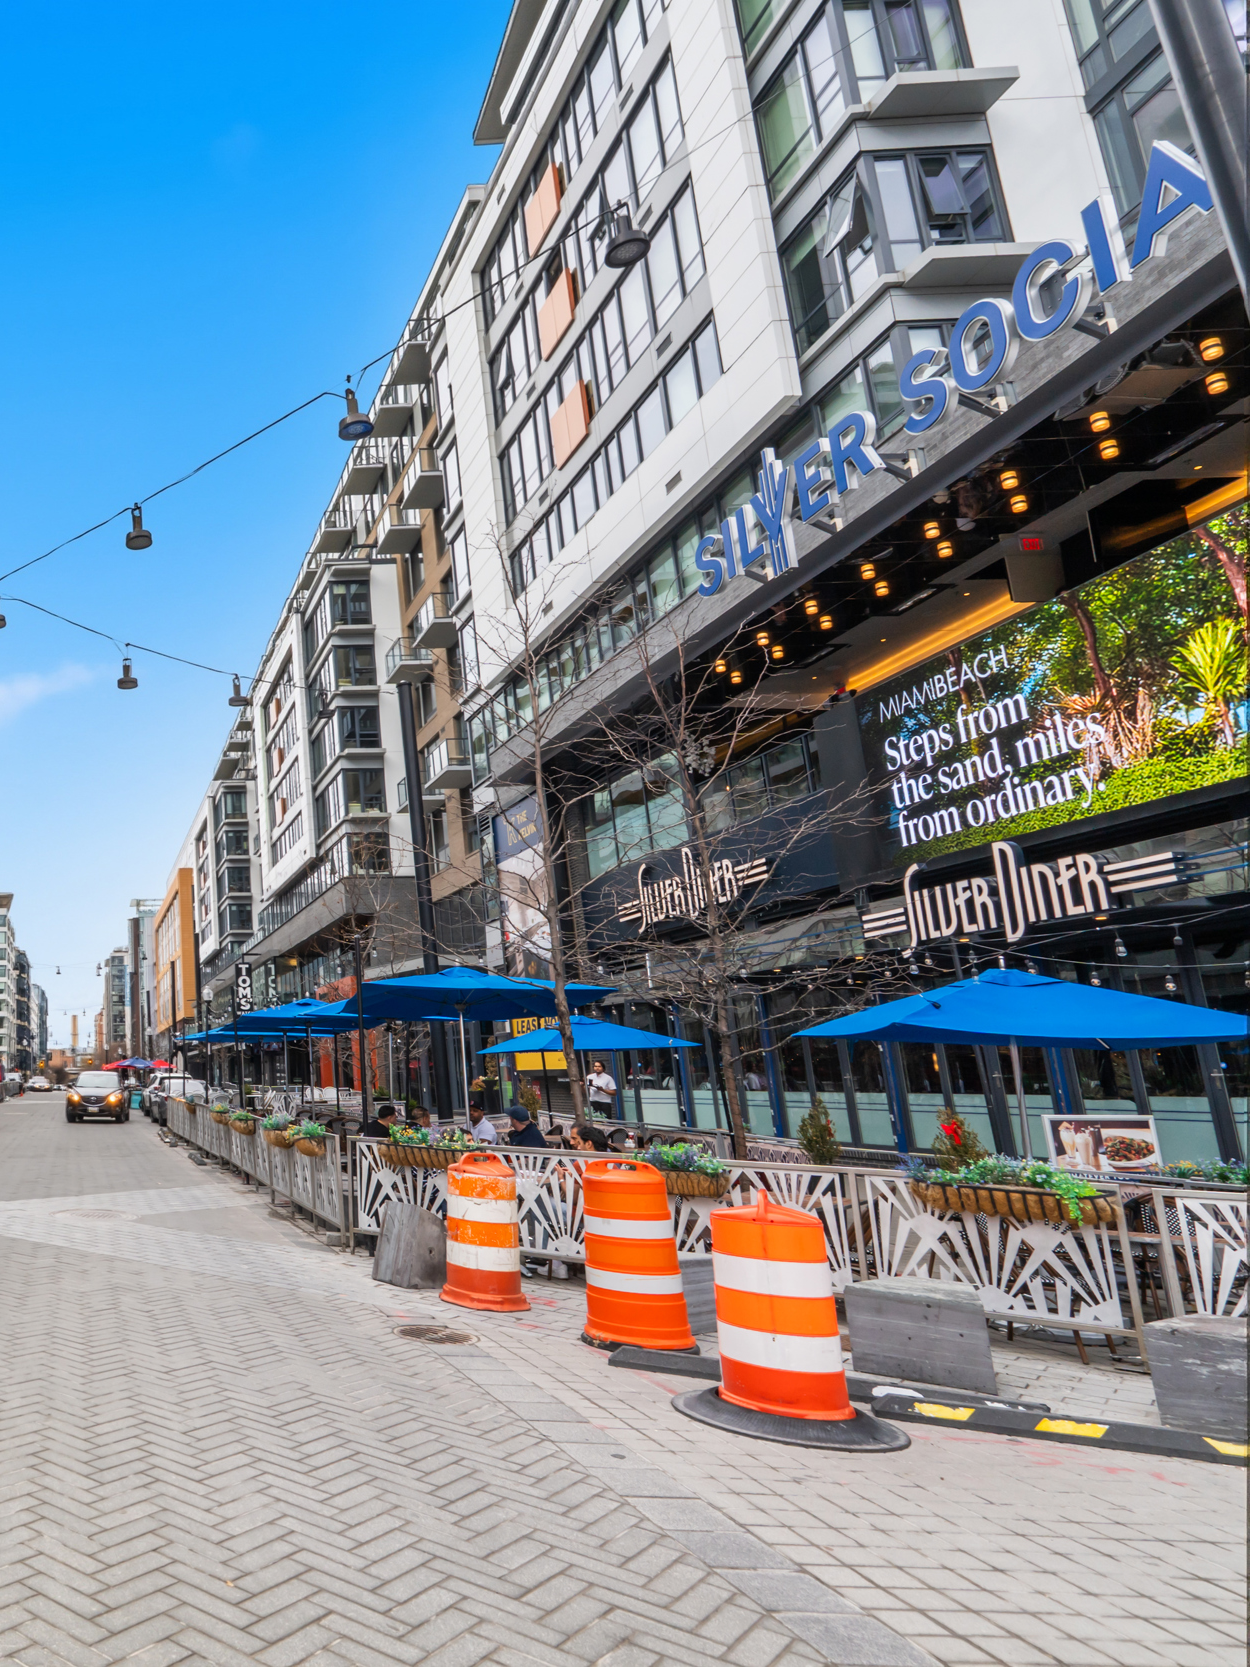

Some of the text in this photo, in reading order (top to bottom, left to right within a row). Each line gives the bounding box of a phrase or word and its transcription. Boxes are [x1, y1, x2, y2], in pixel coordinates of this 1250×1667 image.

[698, 140, 1215, 598] SILVER SOCIA
[879, 644, 1011, 723] MIAMIBEACH
[883, 692, 1030, 771] Steps from
[891, 710, 1106, 809] the sand, miles
[898, 763, 1106, 847] from ordinary.
[638, 863, 687, 934] SILVER
[901, 840, 1109, 959] SILVER DINER
[516, 1018, 538, 1035] LEAS
